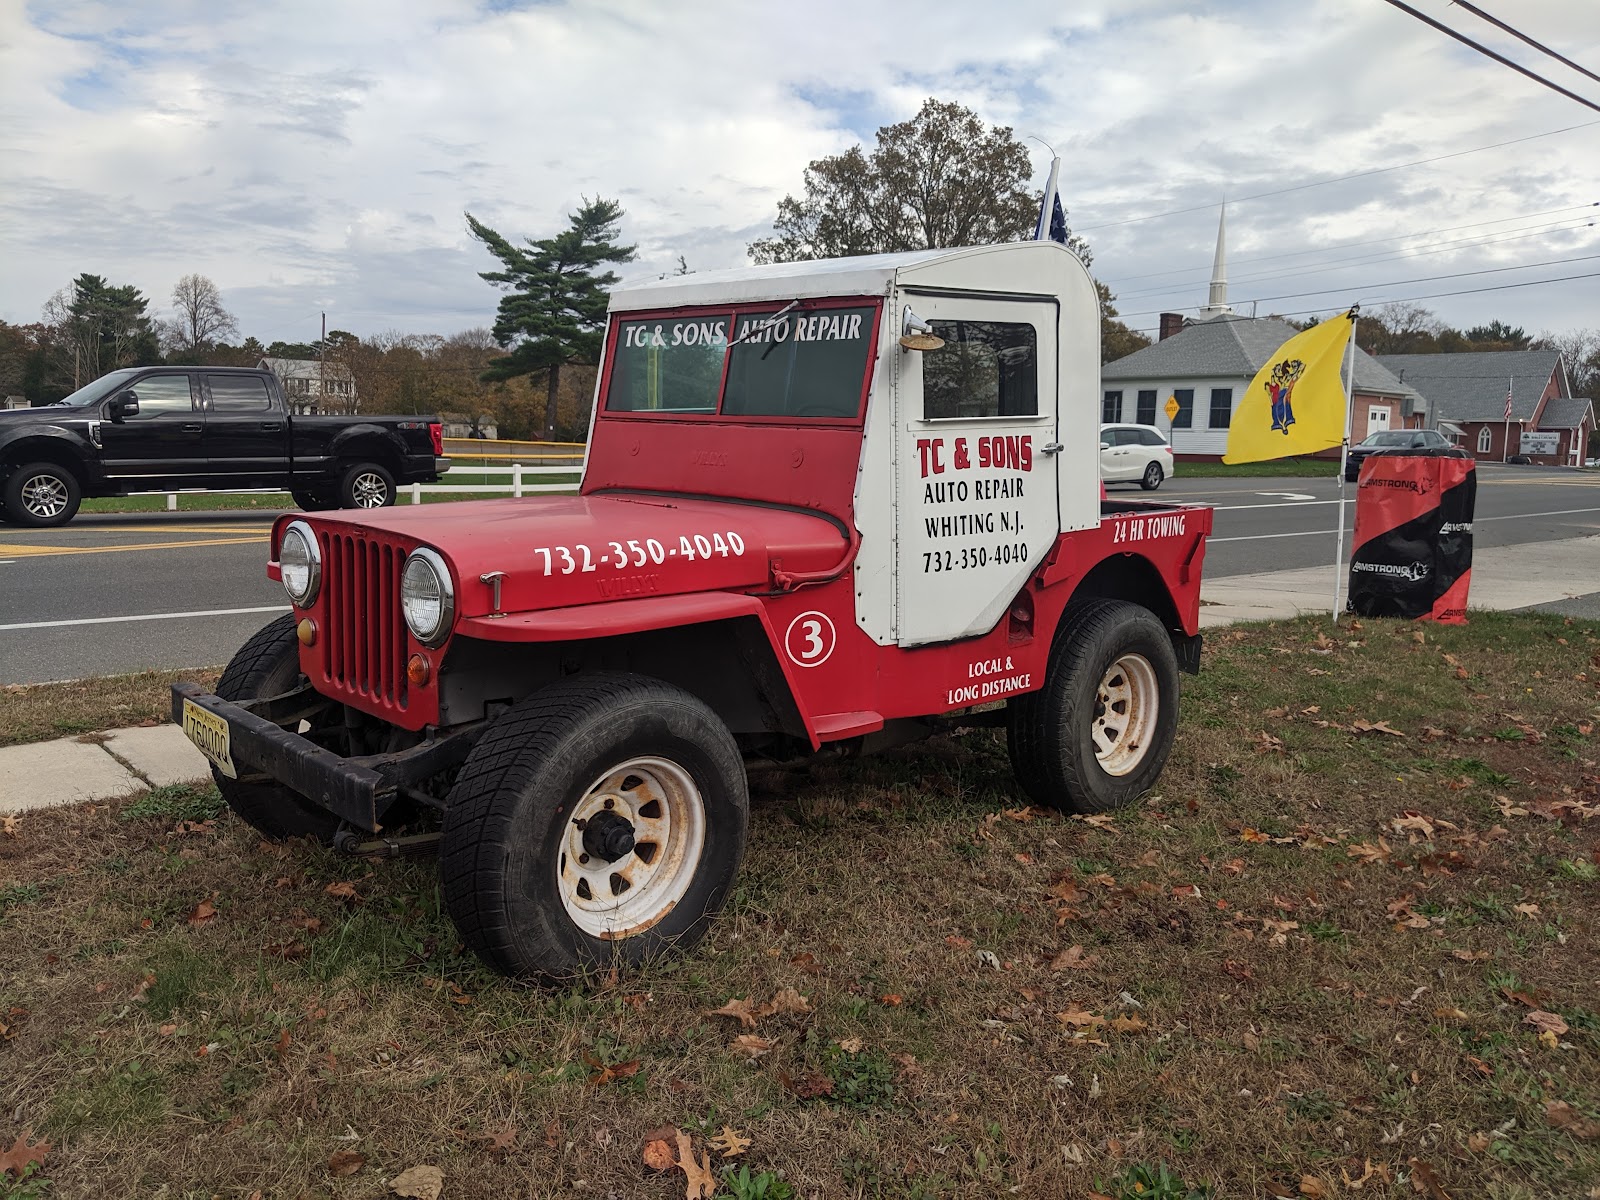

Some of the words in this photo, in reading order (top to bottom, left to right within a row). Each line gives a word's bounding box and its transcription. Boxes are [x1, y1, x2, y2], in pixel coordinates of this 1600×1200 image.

[625, 325, 646, 347] TC
[651, 325, 667, 346] &
[671, 321, 725, 346] SONS
[739, 320, 789, 344] AUTO
[794, 314, 862, 342] REPAIR
[917, 439, 945, 479] TC
[954, 437, 971, 470] &
[979, 435, 1032, 472] SONS
[924, 481, 968, 504] AUTO
[975, 478, 1024, 500] REPAIR
[925, 513, 994, 538] WHITING
[1000, 511, 1024, 535] N.J.
[1113, 521, 1126, 543] 24
[1129, 519, 1144, 541] HR
[1147, 515, 1185, 539] TOWING
[534, 531, 745, 577] 732-350-4040
[923, 543, 1028, 573] 732-350-4040
[1352, 561, 1409, 575] ARMSTRONG
[801, 620, 824, 659] 3
[968, 658, 1003, 678] LOCAL
[1005, 656, 1014, 670] &
[948, 684, 979, 705] LONG
[981, 674, 1031, 698] DISTANCE
[204, 712, 217, 727] Jersey
